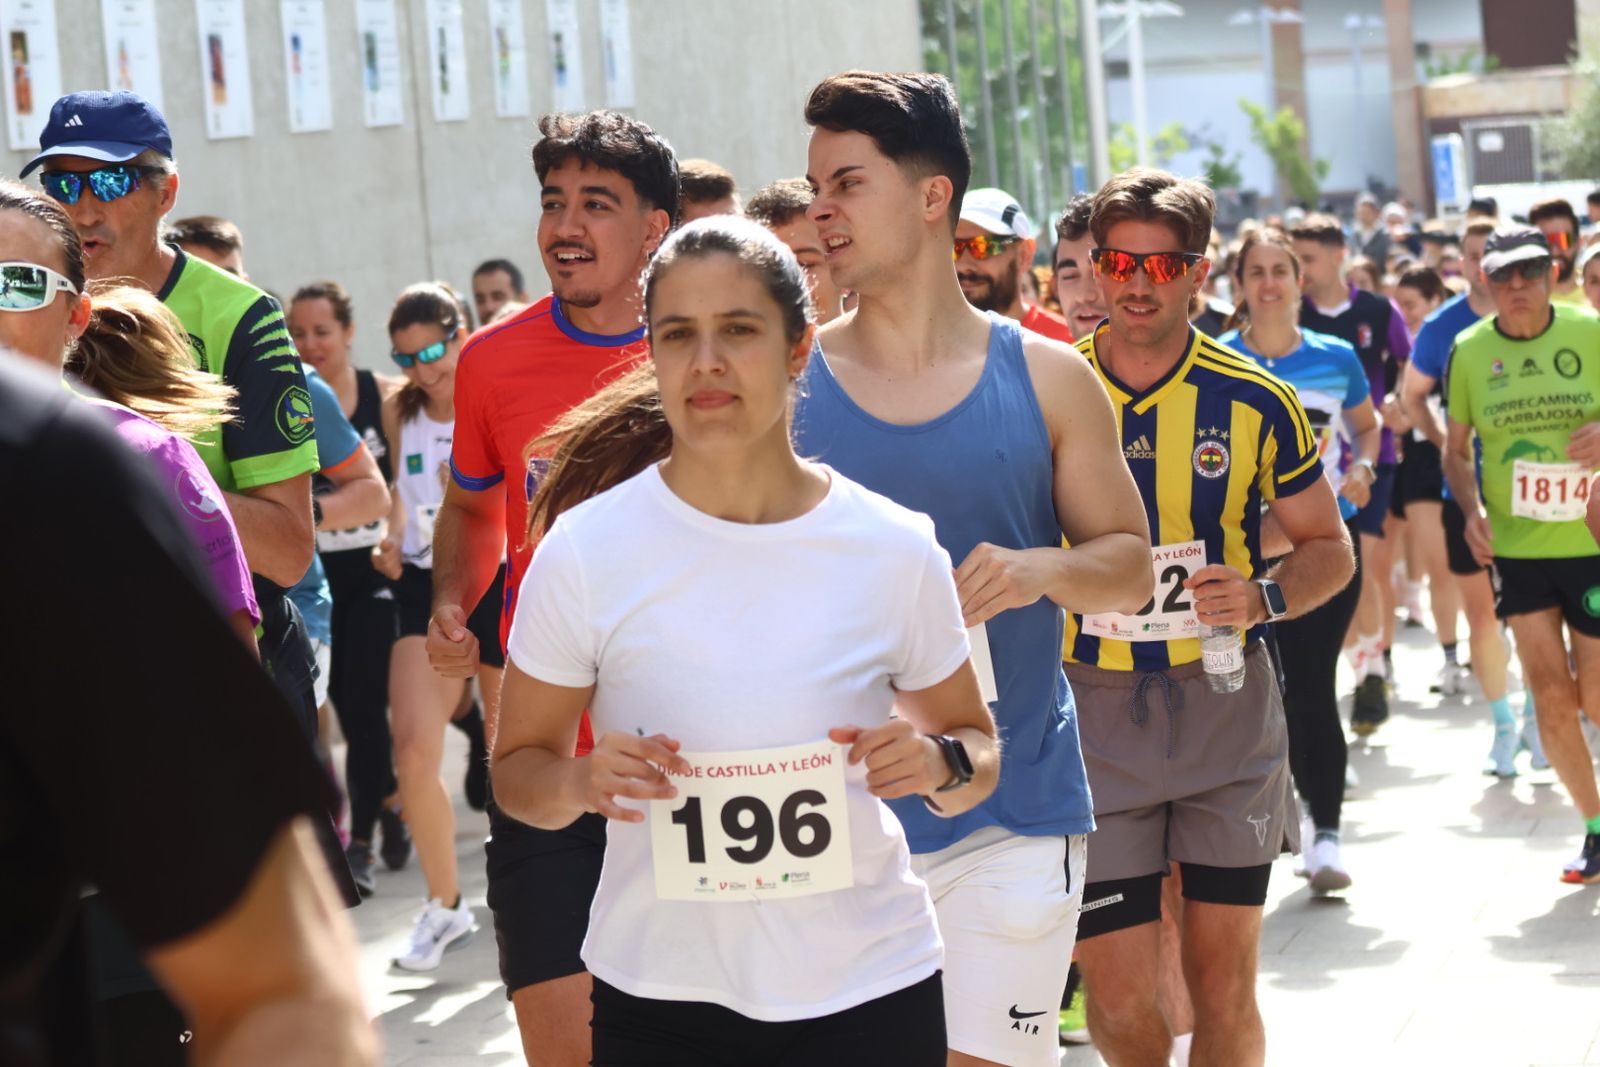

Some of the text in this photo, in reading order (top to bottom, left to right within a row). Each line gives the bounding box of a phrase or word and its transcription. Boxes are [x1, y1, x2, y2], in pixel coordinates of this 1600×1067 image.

[1484, 392, 1595, 416] CORRECAMINOS
[1493, 408, 1584, 427] CARBAJOSA
[1124, 449, 1155, 459] adidas
[1517, 475, 1588, 504] 1814
[1164, 552, 1170, 560] Y
[1173, 547, 1201, 559] LEÓN
[1135, 564, 1191, 616] 2
[685, 766, 703, 778] DE
[707, 763, 776, 778] CASTILLA
[779, 761, 788, 773] Y
[793, 754, 832, 770] LEÓN
[672, 789, 832, 864] 196
[1011, 1020, 1039, 1035] AIR
